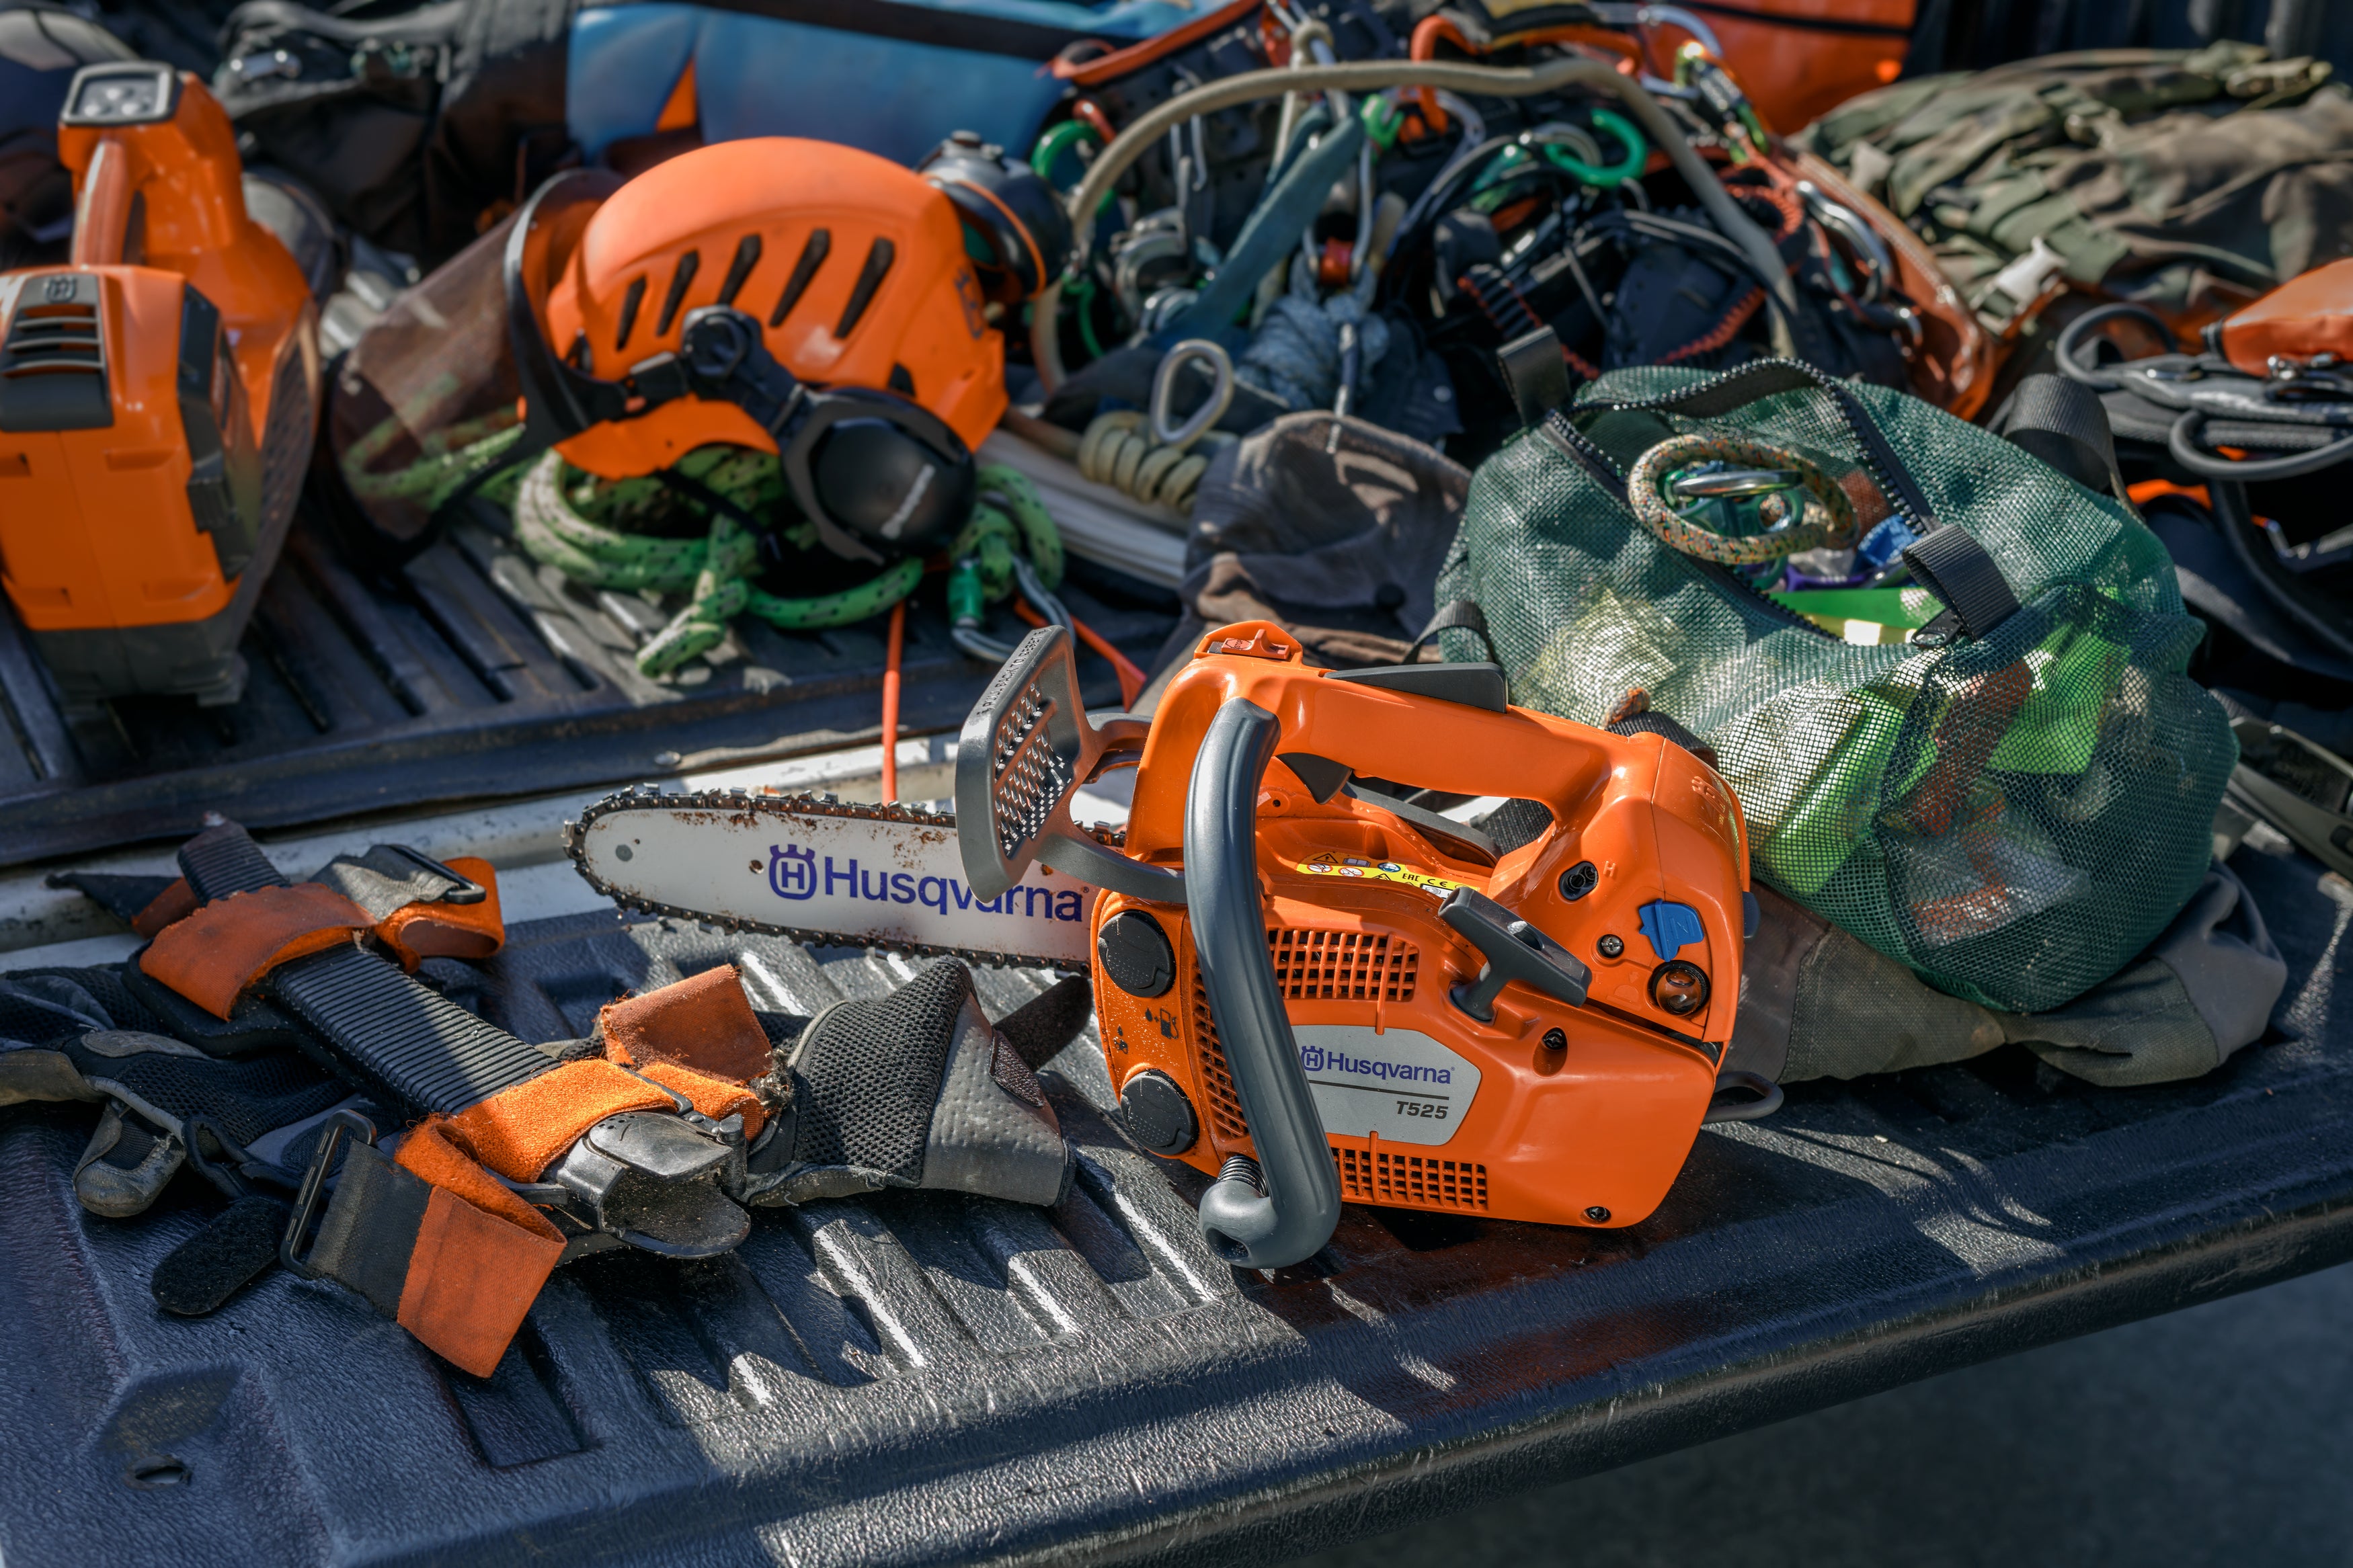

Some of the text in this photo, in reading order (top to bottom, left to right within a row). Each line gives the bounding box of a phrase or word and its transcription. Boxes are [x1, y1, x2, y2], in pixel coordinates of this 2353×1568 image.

[1234, 640, 1242, 649] STOP
[1603, 860, 1616, 877] H
[1396, 1100, 1449, 1120] T525
